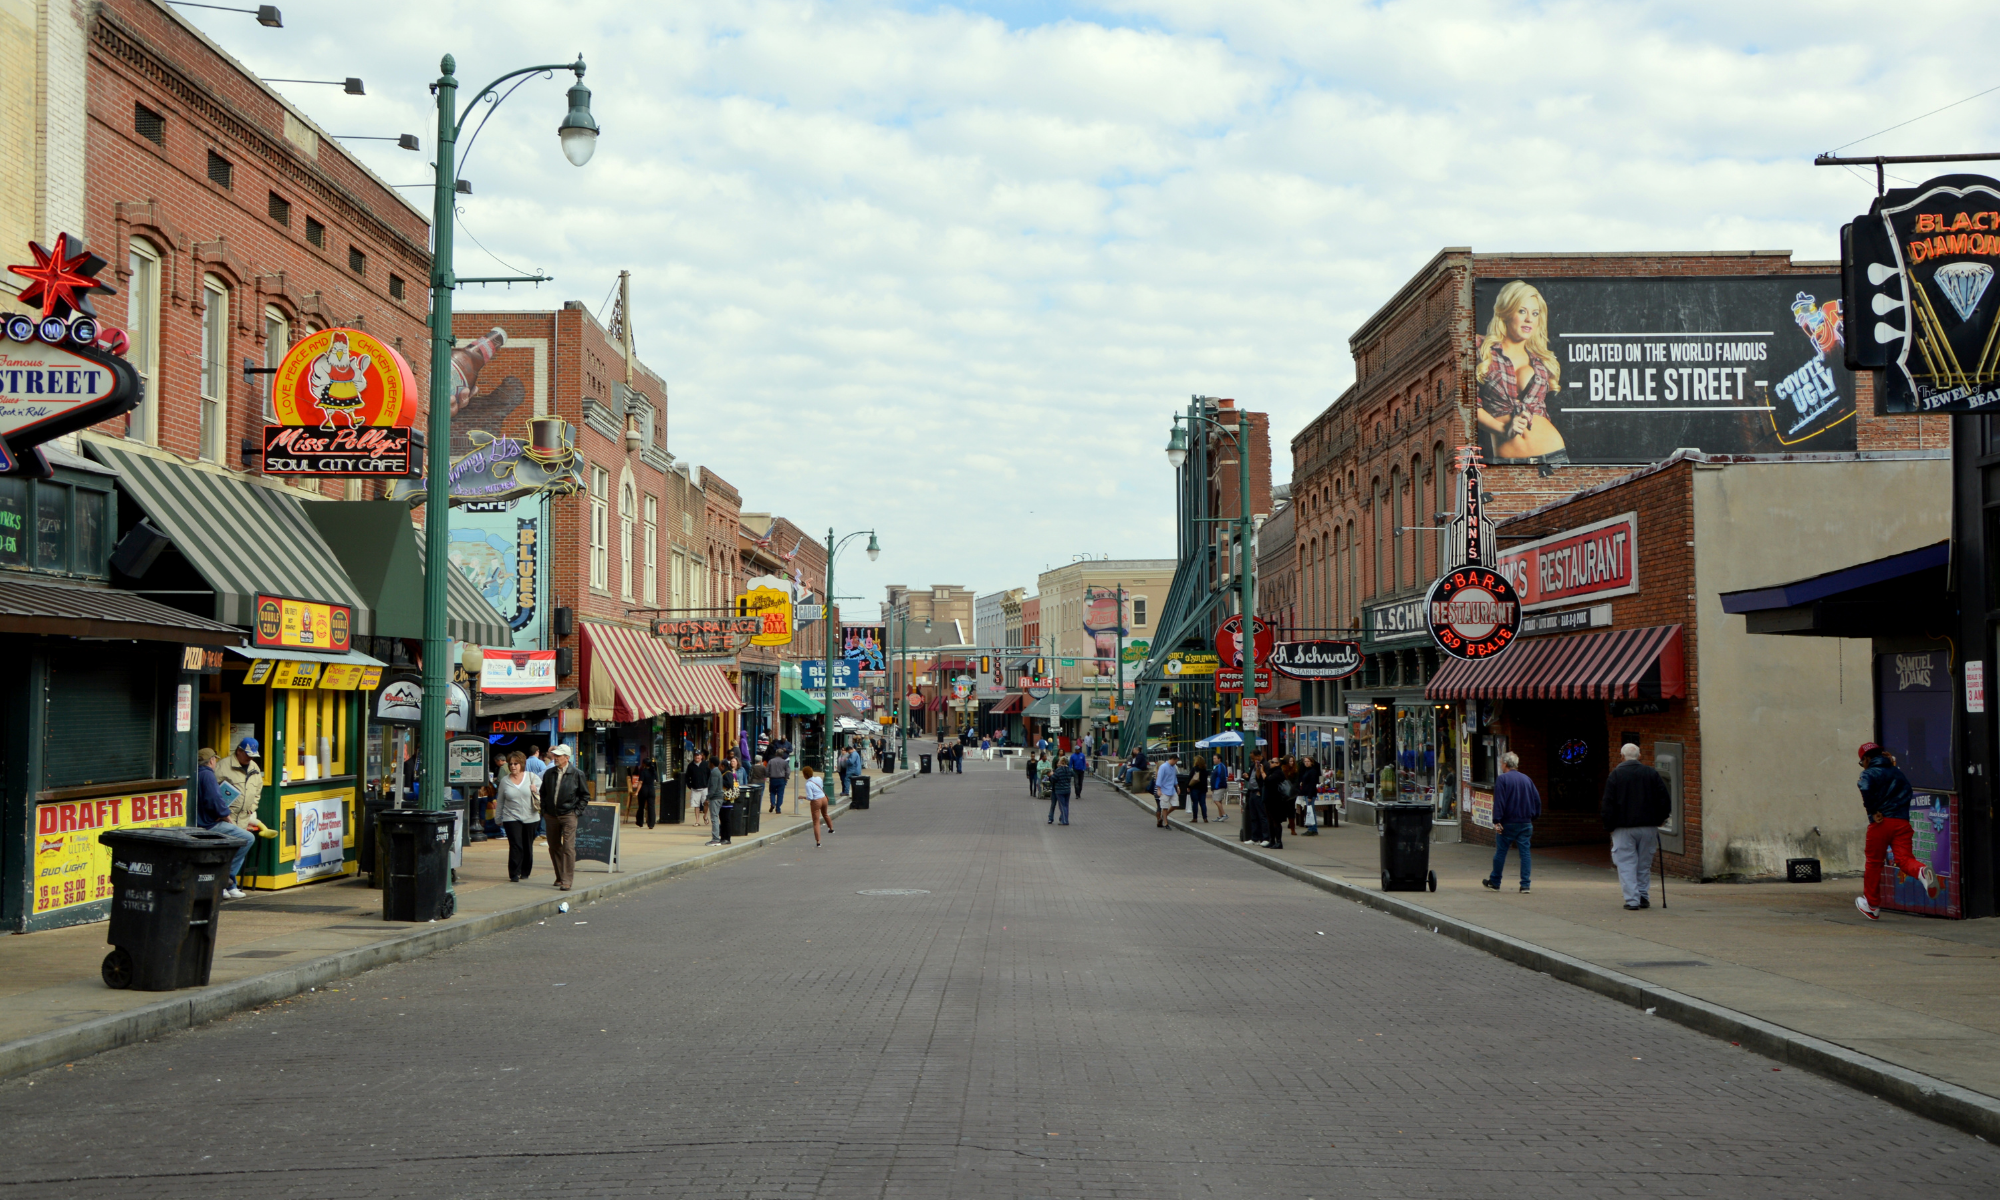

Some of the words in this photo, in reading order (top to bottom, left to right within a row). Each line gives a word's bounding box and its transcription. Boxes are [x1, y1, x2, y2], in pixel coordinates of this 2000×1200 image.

[285, 348, 309, 381] PEACE
[308, 337, 329, 354] AND
[1569, 344, 1622, 362] LOCATED
[1625, 343, 1641, 362] ON
[1644, 343, 1667, 362] THE
[1669, 342, 1713, 361] WORLD
[1715, 342, 1767, 361] FAMOUS
[0, 370, 101, 394] TREET
[357, 339, 392, 374] CHICKEN
[384, 375, 398, 418] GREASE
[1590, 368, 1657, 401] BEALE
[1663, 367, 1747, 401] STREET
[1774, 357, 1825, 400] COYOTE
[1792, 367, 1836, 413] UGLY
[1918, 385, 1937, 398] The
[1971, 383, 1982, 395] of
[27, 407, 53, 417] Roll
[267, 428, 330, 452] Miss
[266, 458, 316, 471] SOUL
[318, 459, 356, 471] CITY
[358, 459, 406, 472] CAFE
[1467, 478, 1478, 559] FLYNN'S
[518, 530, 535, 608] BLUES
[1539, 531, 1627, 595] RESTAURANT
[1454, 570, 1495, 590] BAR
[260, 610, 280, 622] DOUBLE
[761, 612, 785, 622] TAP
[799, 605, 821, 618] CARGO
[1086, 610, 1111, 626] PEPSI
[1431, 601, 1515, 624] RESTAURANT
[332, 619, 347, 629] DOUBLE
[1560, 613, 1576, 627] BAR-B-Q
[1576, 611, 1587, 624] PORK
[263, 623, 277, 633] COLA
[335, 630, 345, 639] COLA
[658, 620, 700, 635] KING'S
[703, 620, 756, 633] PALACE
[680, 636, 734, 651] CAFE
[1440, 628, 1462, 649] 159
[1467, 628, 1512, 656] BEALE
[183, 646, 203, 670] PIZZA
[1274, 645, 1293, 663] A.
[1294, 645, 1359, 664] Schwab
[297, 663, 316, 675] COLD
[328, 664, 346, 675] Chicken
[1895, 653, 1934, 675] SAMUEL
[808, 666, 851, 677] BLES
[1290, 668, 1333, 676] ESTABLISHED
[291, 676, 313, 687] BEER
[326, 675, 340, 686] Wings
[1899, 669, 1932, 691] ADAMS
[384, 693, 404, 702] Coors
[1968, 690, 1973, 700] 3
[1622, 703, 1660, 715] ATM
[493, 721, 527, 732] PATIO
[38, 799, 122, 836] DRAFT
[131, 792, 184, 823] BEER
[322, 811, 337, 820] Welcome
[328, 831, 333, 839] to
[68, 842, 91, 855] ULTRA
[330, 839, 340, 849] Street
[41, 866, 61, 877] BUD
[63, 862, 88, 874] LIGHT
[97, 874, 105, 886] 16
[39, 885, 49, 898] 16
[51, 886, 61, 896] OZ.
[63, 878, 86, 893] $3.00
[95, 886, 106, 898] 32
[38, 898, 50, 911] 32
[51, 898, 62, 908] OZ.
[63, 891, 86, 905] $5.00
